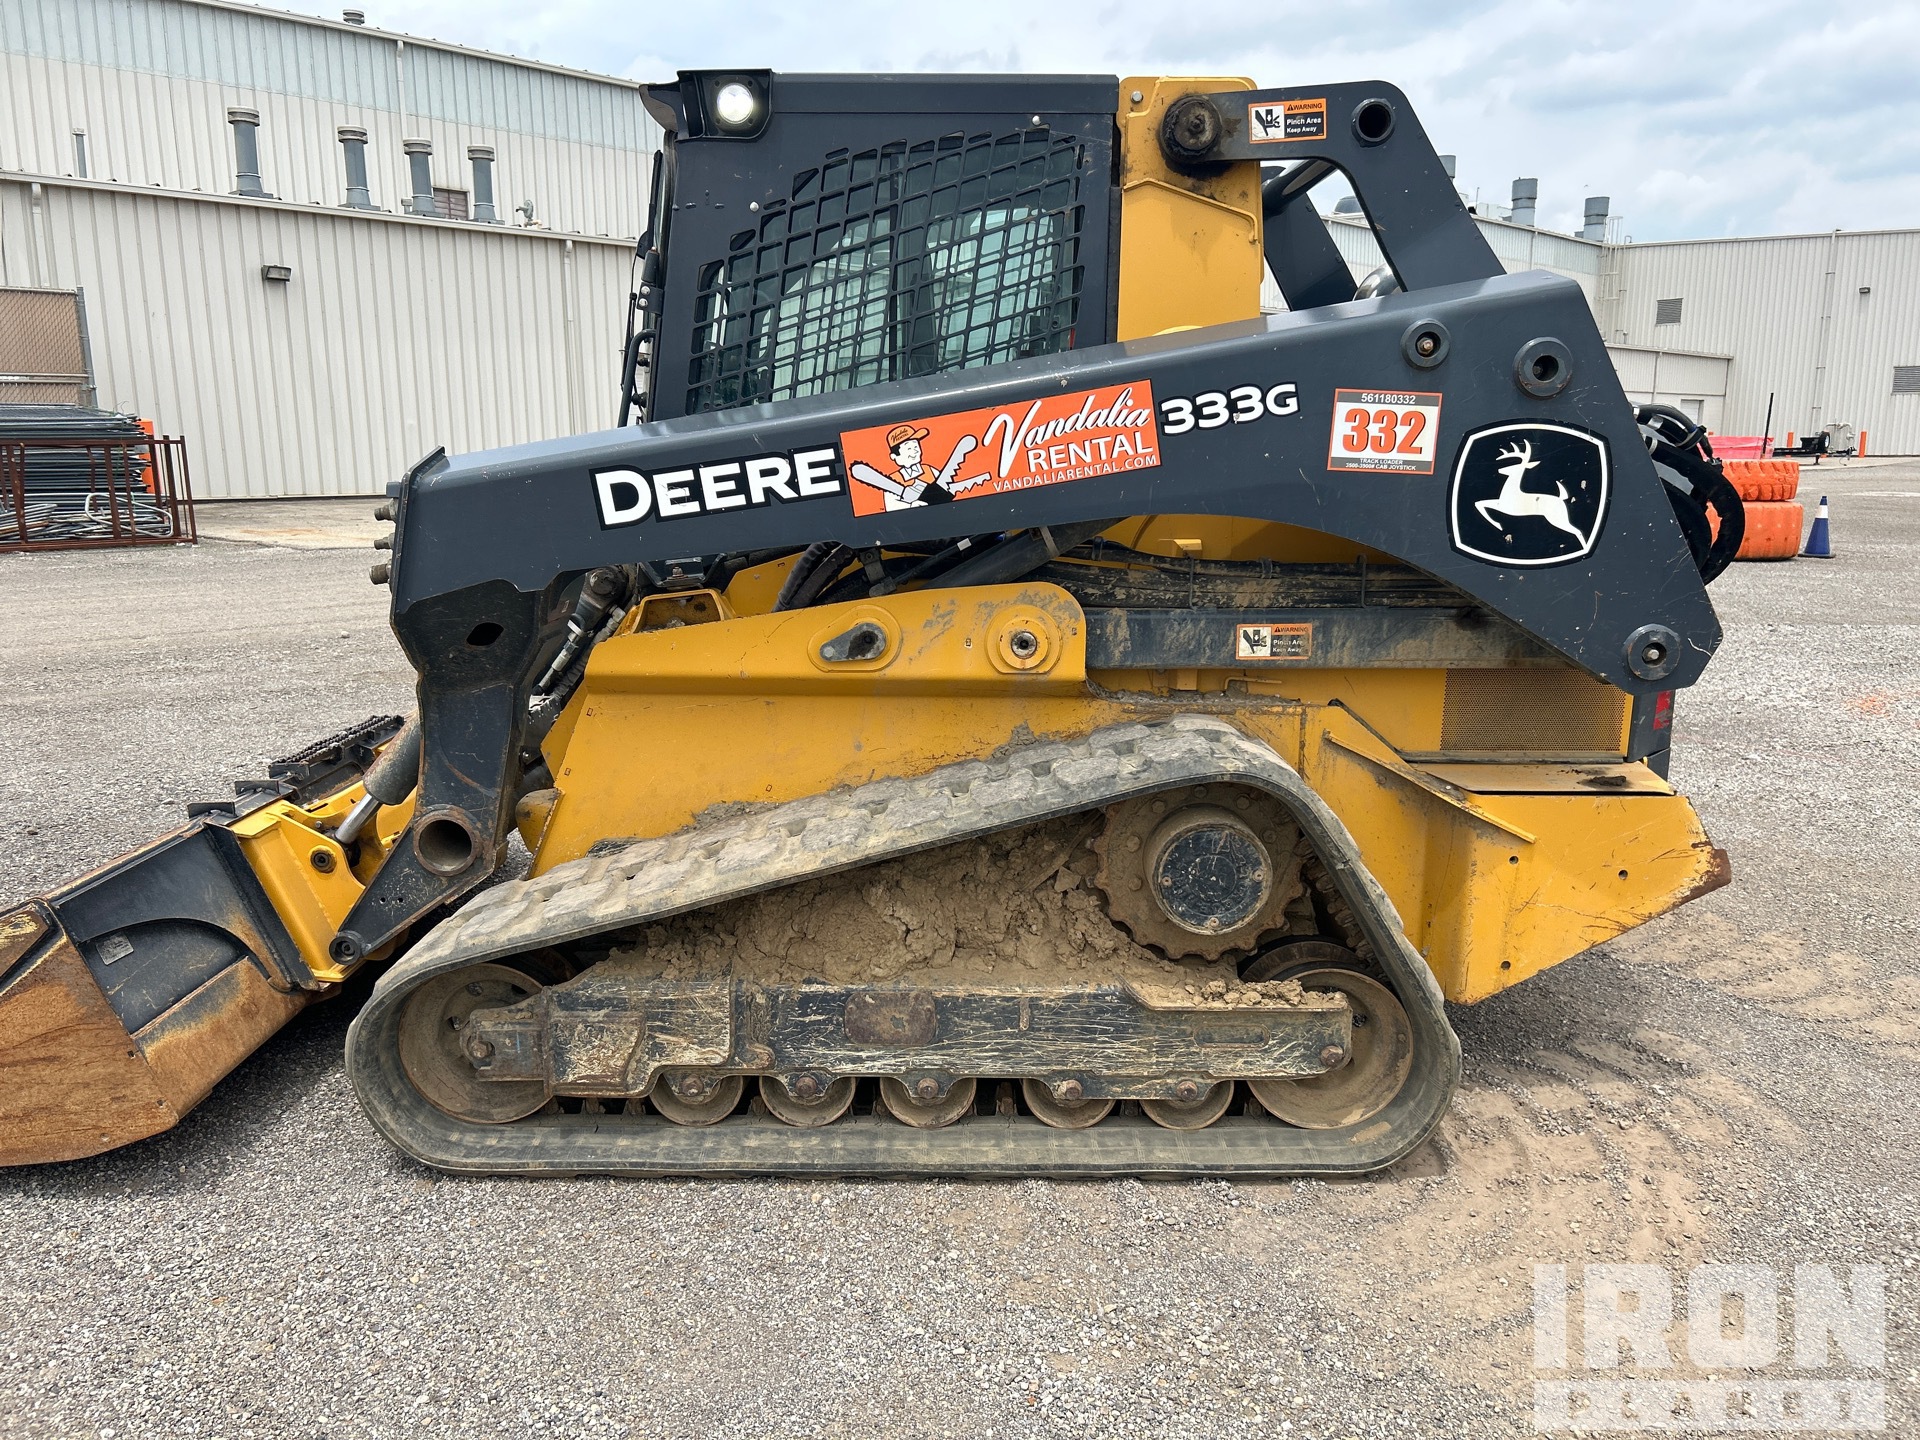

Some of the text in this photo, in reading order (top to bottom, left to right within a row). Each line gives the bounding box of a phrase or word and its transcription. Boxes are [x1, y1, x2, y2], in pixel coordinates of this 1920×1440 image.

[1286, 118, 1305, 126] Pinch
[1161, 383, 1299, 434] 333G
[1361, 393, 1416, 404] 561180332
[981, 387, 1152, 478] Vandalia
[1025, 432, 1154, 472] RENTAL
[1342, 408, 1426, 454] 332
[594, 448, 841, 526] DEERE
[992, 454, 1157, 492] VANDALIARENTAL.COM
